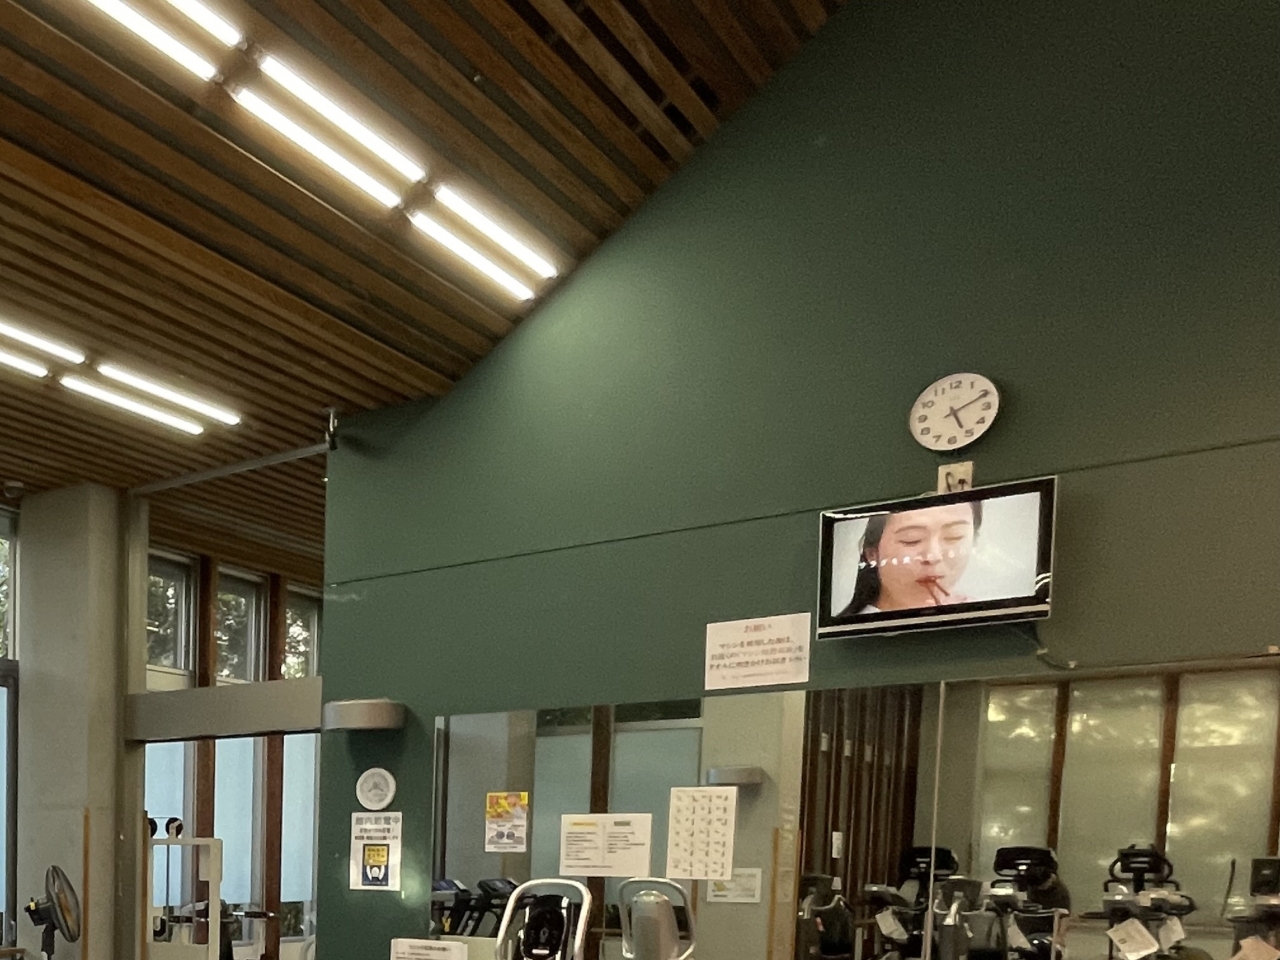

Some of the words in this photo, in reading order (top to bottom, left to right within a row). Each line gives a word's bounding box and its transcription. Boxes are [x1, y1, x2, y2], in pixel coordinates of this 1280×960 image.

[949, 380, 963, 390] 12
[934, 387, 946, 397] 11
[921, 400, 935, 409] 10
[981, 401, 992, 411] 3
[918, 414, 928, 424] 9
[976, 416, 985, 425] 4
[920, 426, 931, 436] 8
[964, 428, 974, 437] 5
[932, 434, 942, 444] 7
[947, 436, 957, 445] 6
